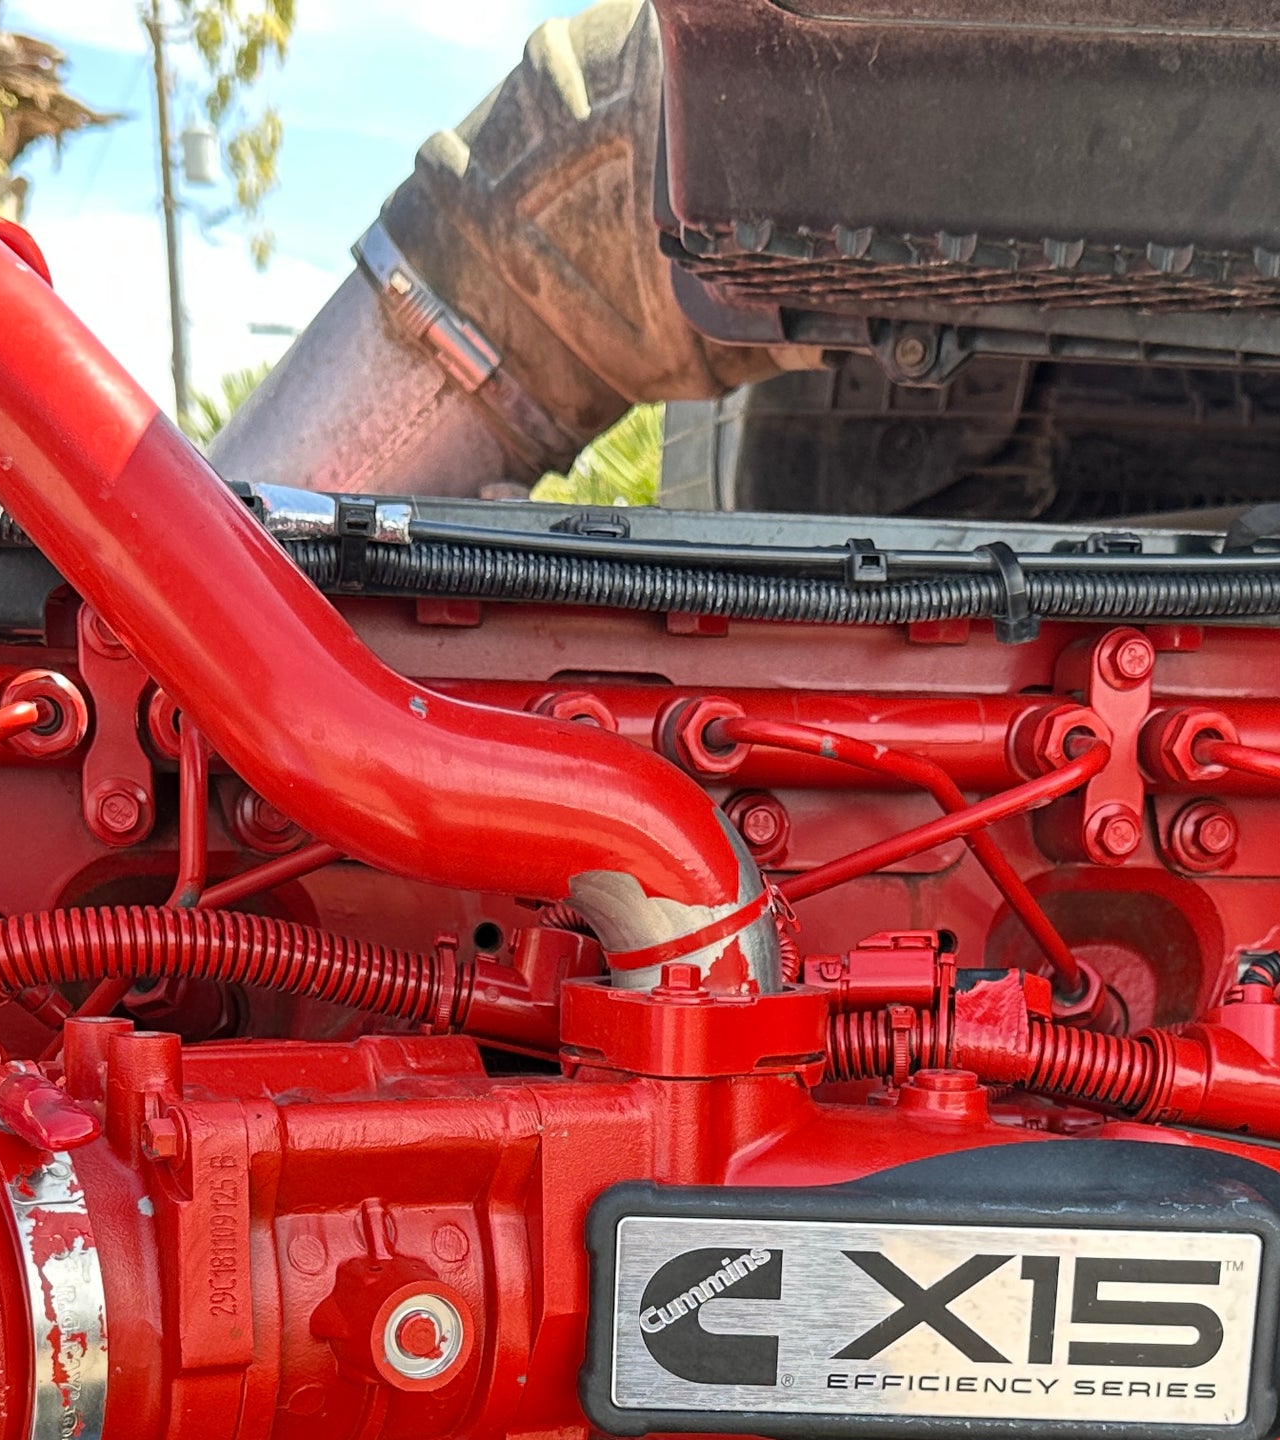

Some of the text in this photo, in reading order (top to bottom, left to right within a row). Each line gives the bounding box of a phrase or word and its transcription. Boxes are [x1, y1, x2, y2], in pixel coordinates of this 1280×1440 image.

[639, 1247, 771, 1335] Cummins
[828, 1249, 1225, 1369] X15
[827, 1373, 1218, 1400] EFFICIENCY SERIES
